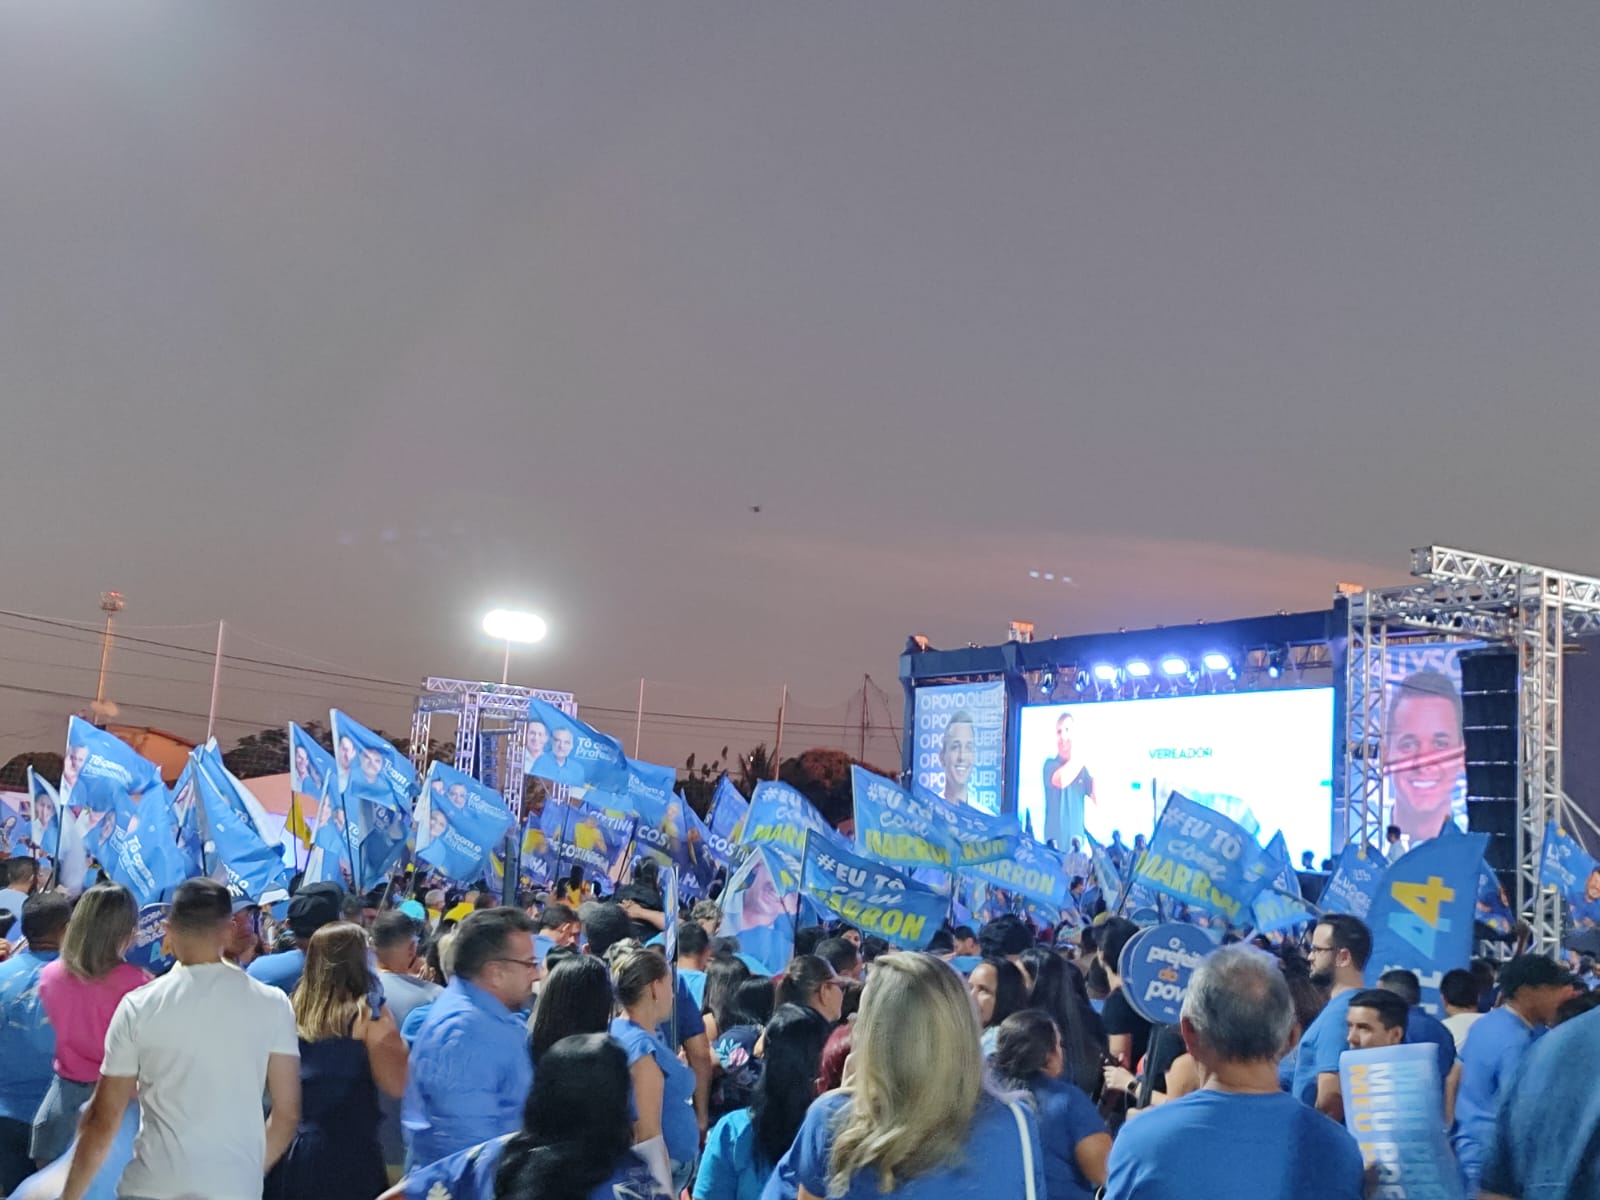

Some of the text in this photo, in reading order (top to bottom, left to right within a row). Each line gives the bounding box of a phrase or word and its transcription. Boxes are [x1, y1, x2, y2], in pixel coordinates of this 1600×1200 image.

[1148, 747, 1213, 760] VEREADOR
[816, 853, 867, 888] #EU
[1143, 980, 1186, 1003] pov
